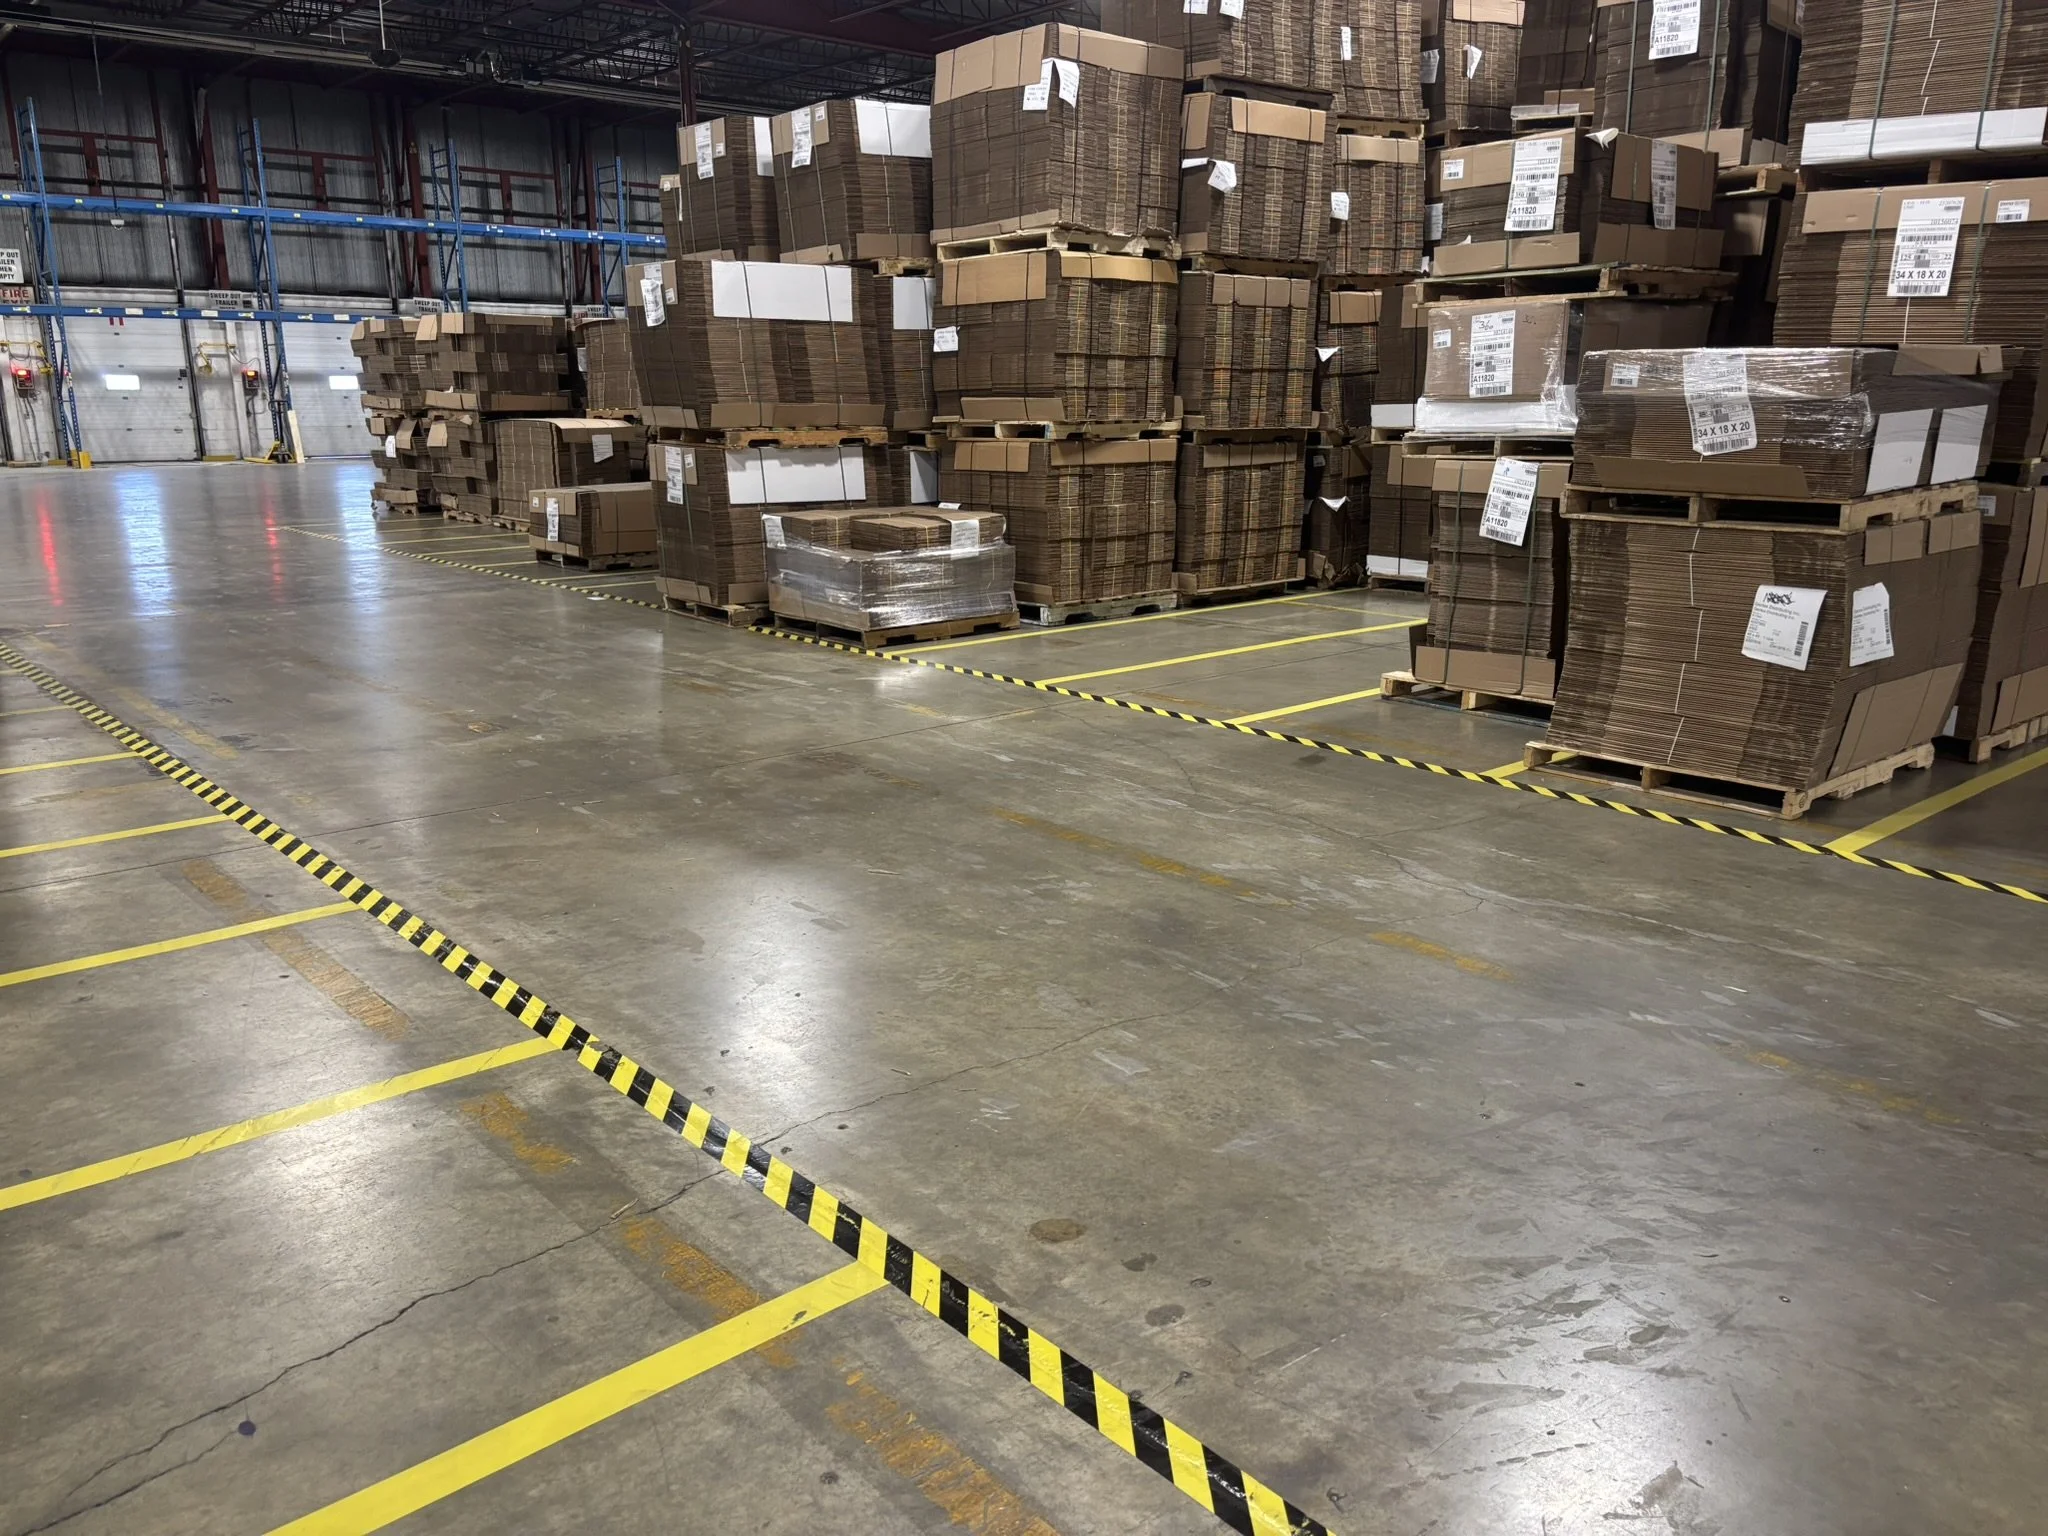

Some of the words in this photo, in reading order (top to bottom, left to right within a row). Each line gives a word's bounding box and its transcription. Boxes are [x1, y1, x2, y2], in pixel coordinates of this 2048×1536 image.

[1512, 206, 1537, 215] A11820
[1896, 270, 1906, 280] 34
[1907, 270, 1914, 279] X
[1916, 270, 1926, 279] 18
[1927, 270, 1935, 279] X
[1936, 270, 1947, 279] 20
[2, 289, 29, 298] FIRE
[1474, 374, 1495, 383] A11820
[1698, 428, 1708, 438] 34
[1710, 427, 1717, 436] X
[1719, 425, 1729, 434] 18
[1730, 423, 1738, 433] X
[1739, 421, 1750, 431] 20
[1486, 516, 1508, 528] A11820
